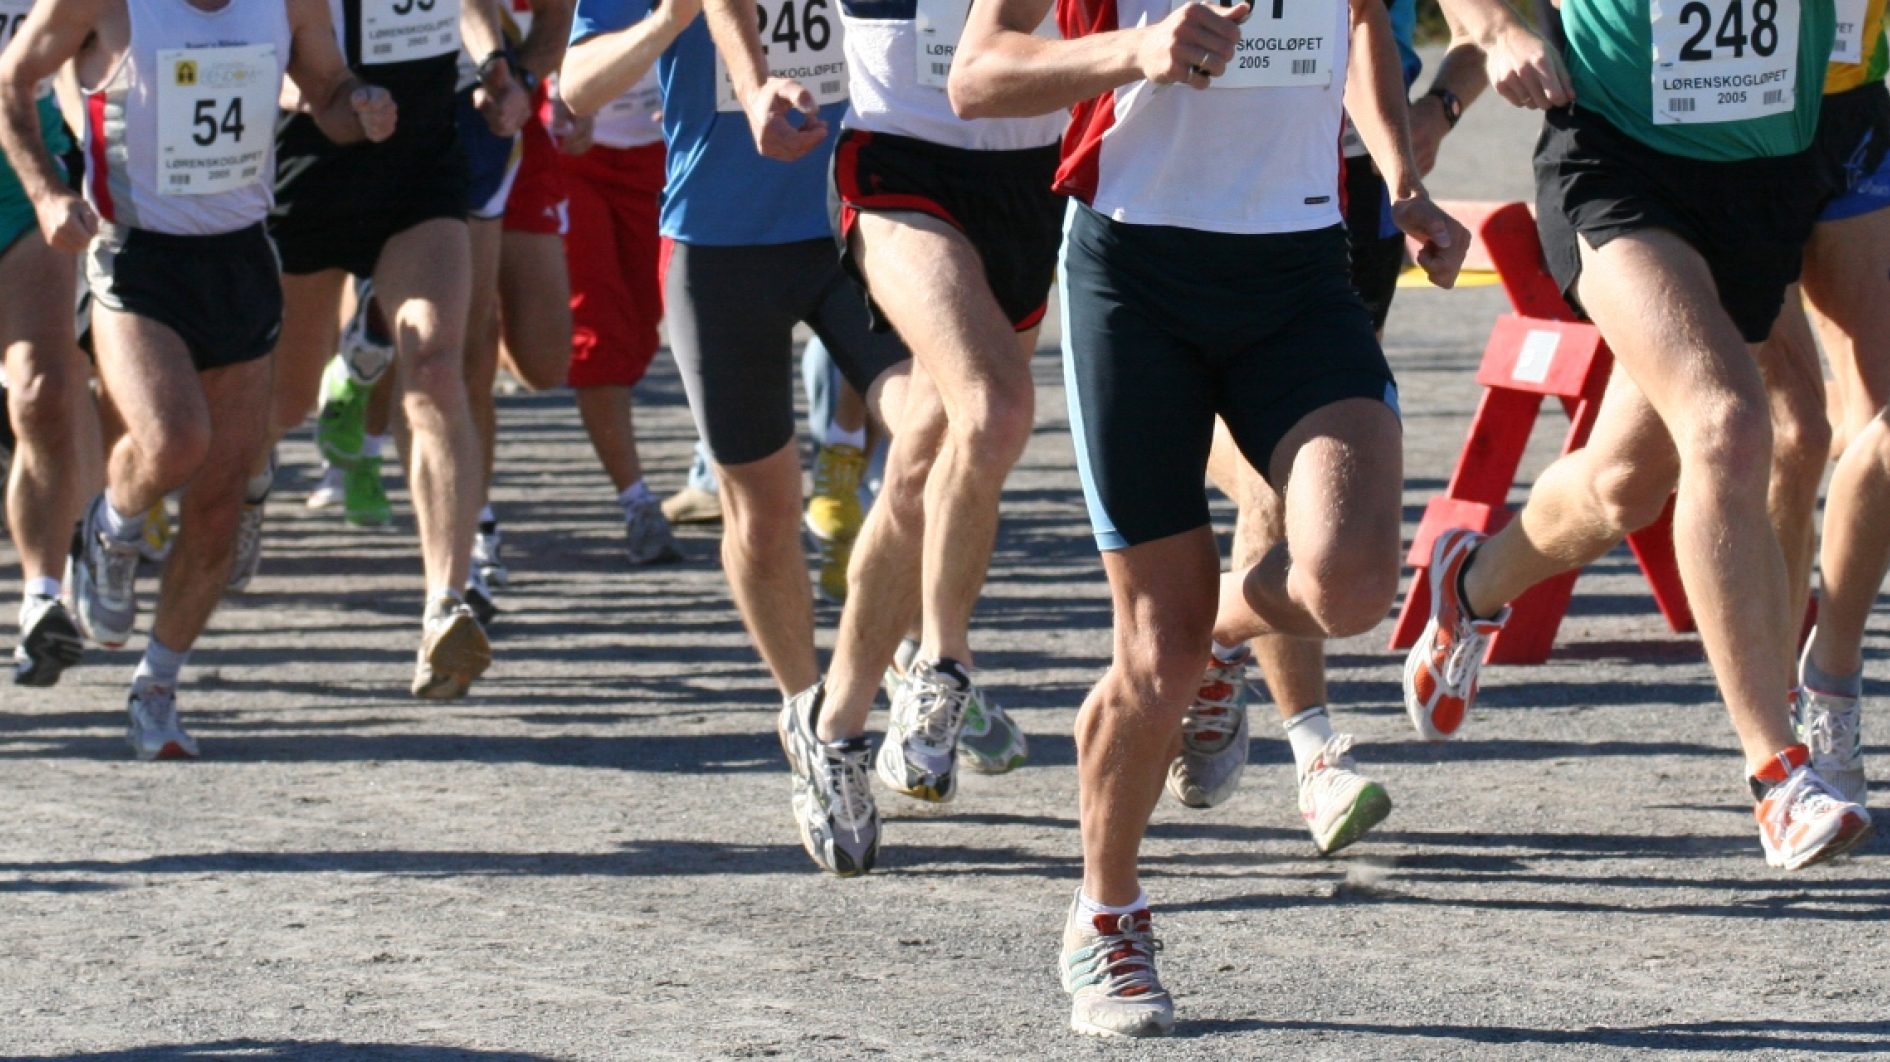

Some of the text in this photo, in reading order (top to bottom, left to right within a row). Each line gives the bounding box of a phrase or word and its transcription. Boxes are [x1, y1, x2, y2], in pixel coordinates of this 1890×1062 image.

[1679, 0, 1778, 61] 248
[1236, 37, 1323, 51] SKOGLØPET
[771, 62, 844, 79] SKOGLØPET
[1239, 56, 1270, 69] 2005
[1663, 69, 1787, 90] LØRENSKOGLØPET
[1717, 91, 1747, 104] 2005
[192, 95, 245, 147] 54
